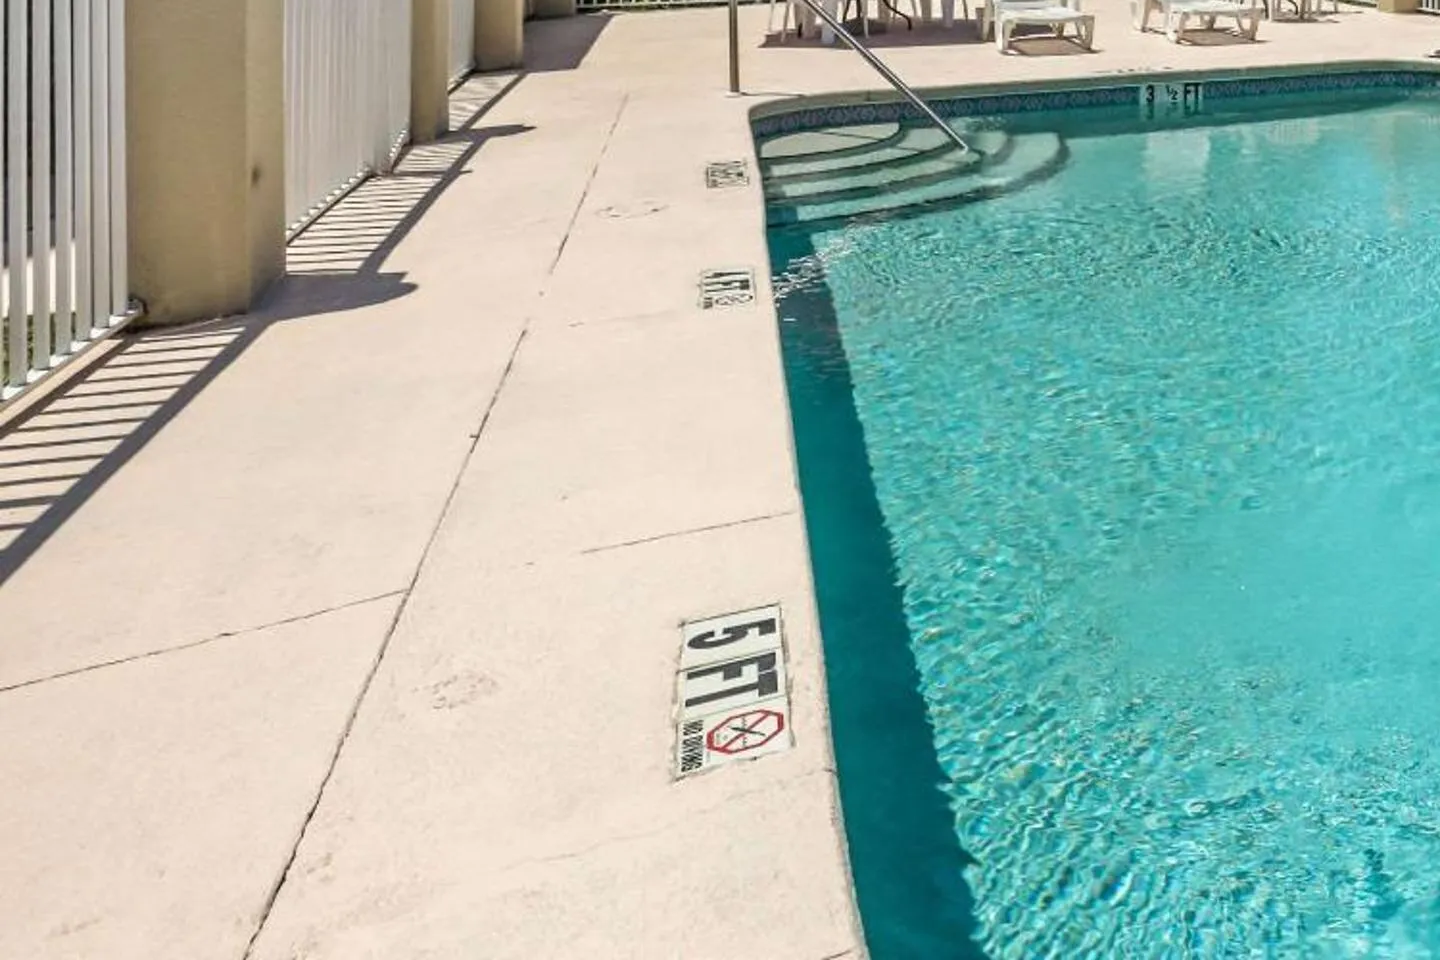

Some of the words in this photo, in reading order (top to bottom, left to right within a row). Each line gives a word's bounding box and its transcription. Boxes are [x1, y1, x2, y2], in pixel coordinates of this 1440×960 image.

[1184, 83, 1201, 105] FT
[687, 618, 776, 649] 5
[685, 652, 778, 708] FT
